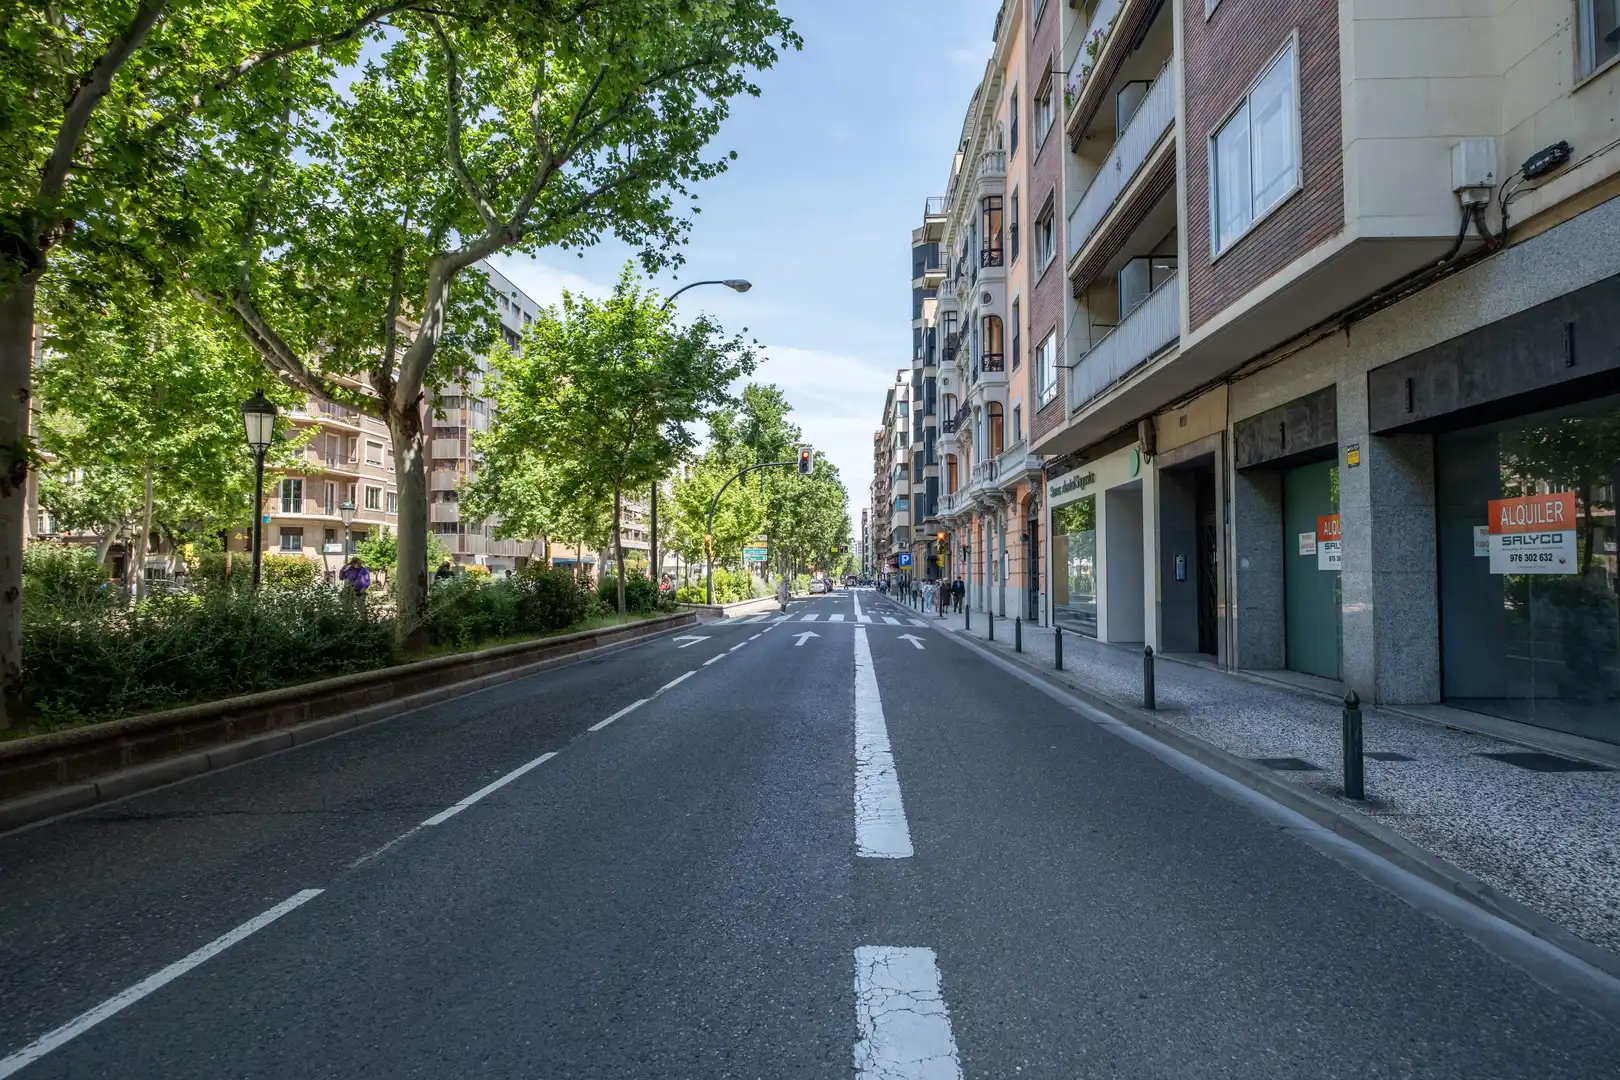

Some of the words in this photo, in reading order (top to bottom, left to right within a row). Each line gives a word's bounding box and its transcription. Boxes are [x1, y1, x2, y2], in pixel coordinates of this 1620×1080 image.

[1501, 501, 1563, 526] ALQUILER
[1324, 520, 1341, 535] ALQU
[1502, 534, 1562, 545] SALYCO
[902, 555, 909, 564] P
[1510, 554, 1522, 562] 976
[1525, 553, 1537, 562] 302
[1539, 553, 1552, 561] 632
